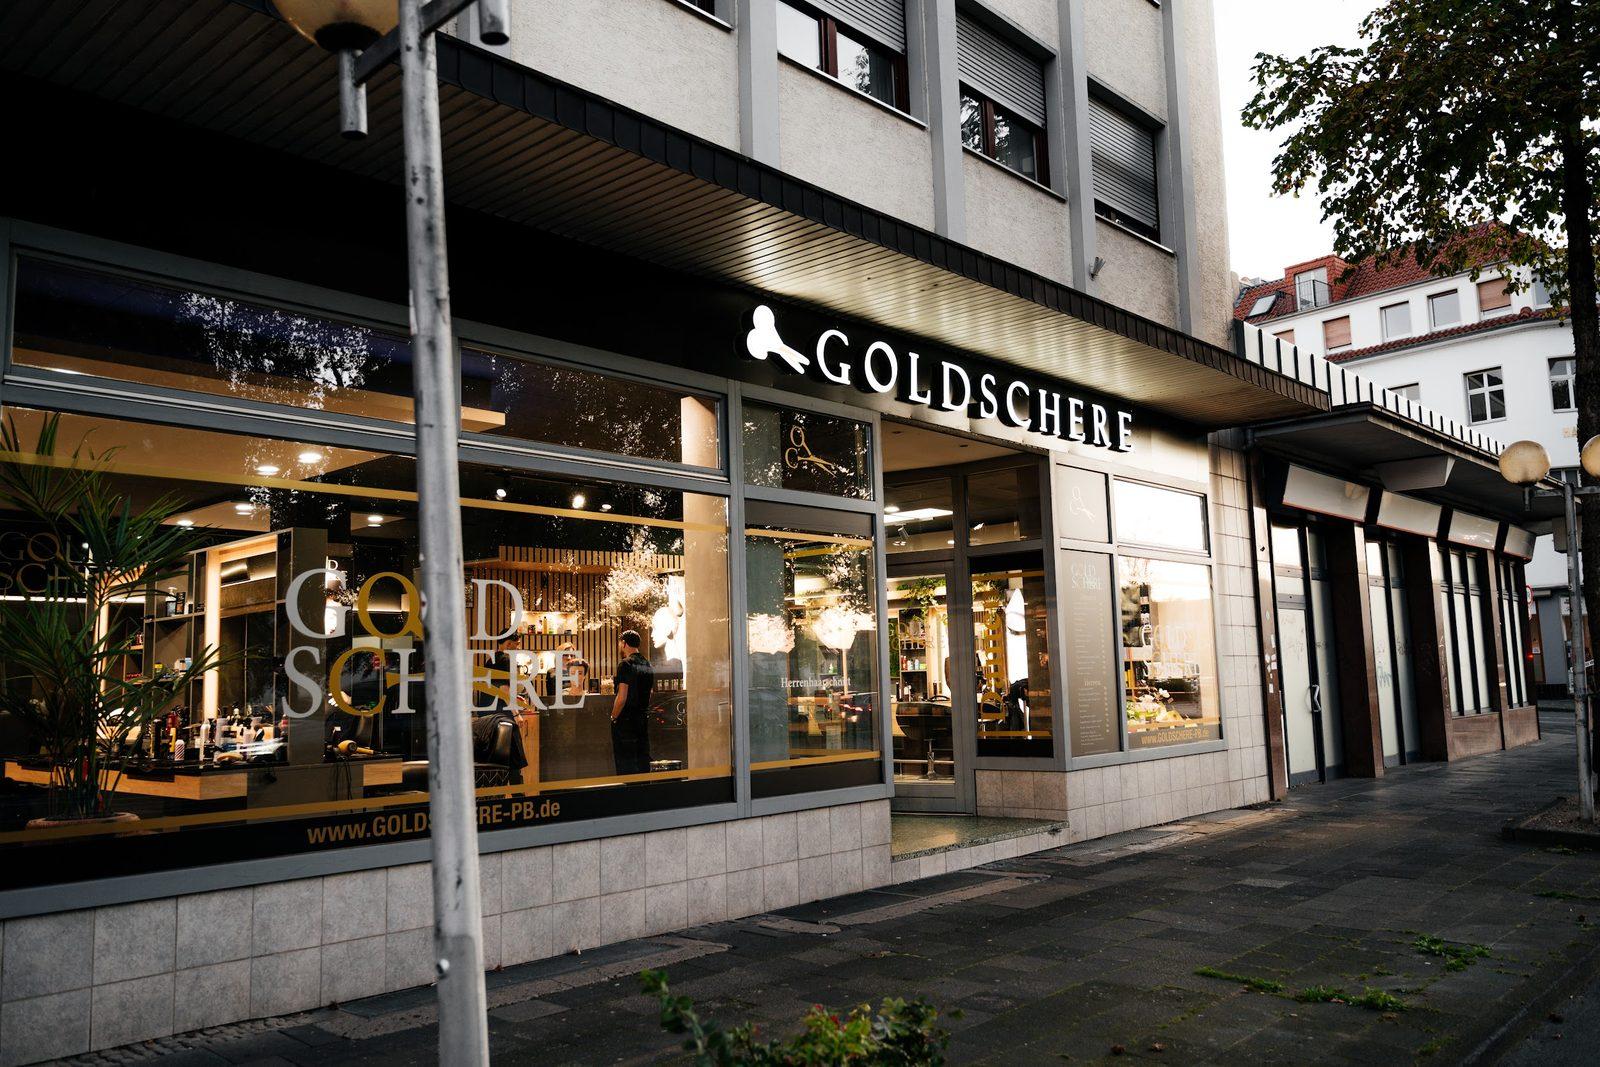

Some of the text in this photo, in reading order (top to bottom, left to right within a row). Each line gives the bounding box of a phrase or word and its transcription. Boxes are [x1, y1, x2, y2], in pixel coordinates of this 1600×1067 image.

[816, 329, 1134, 452] GOLDSCHERE
[285, 568, 524, 640] GOD
[307, 800, 561, 844] www.GOLDRE-PB.de
